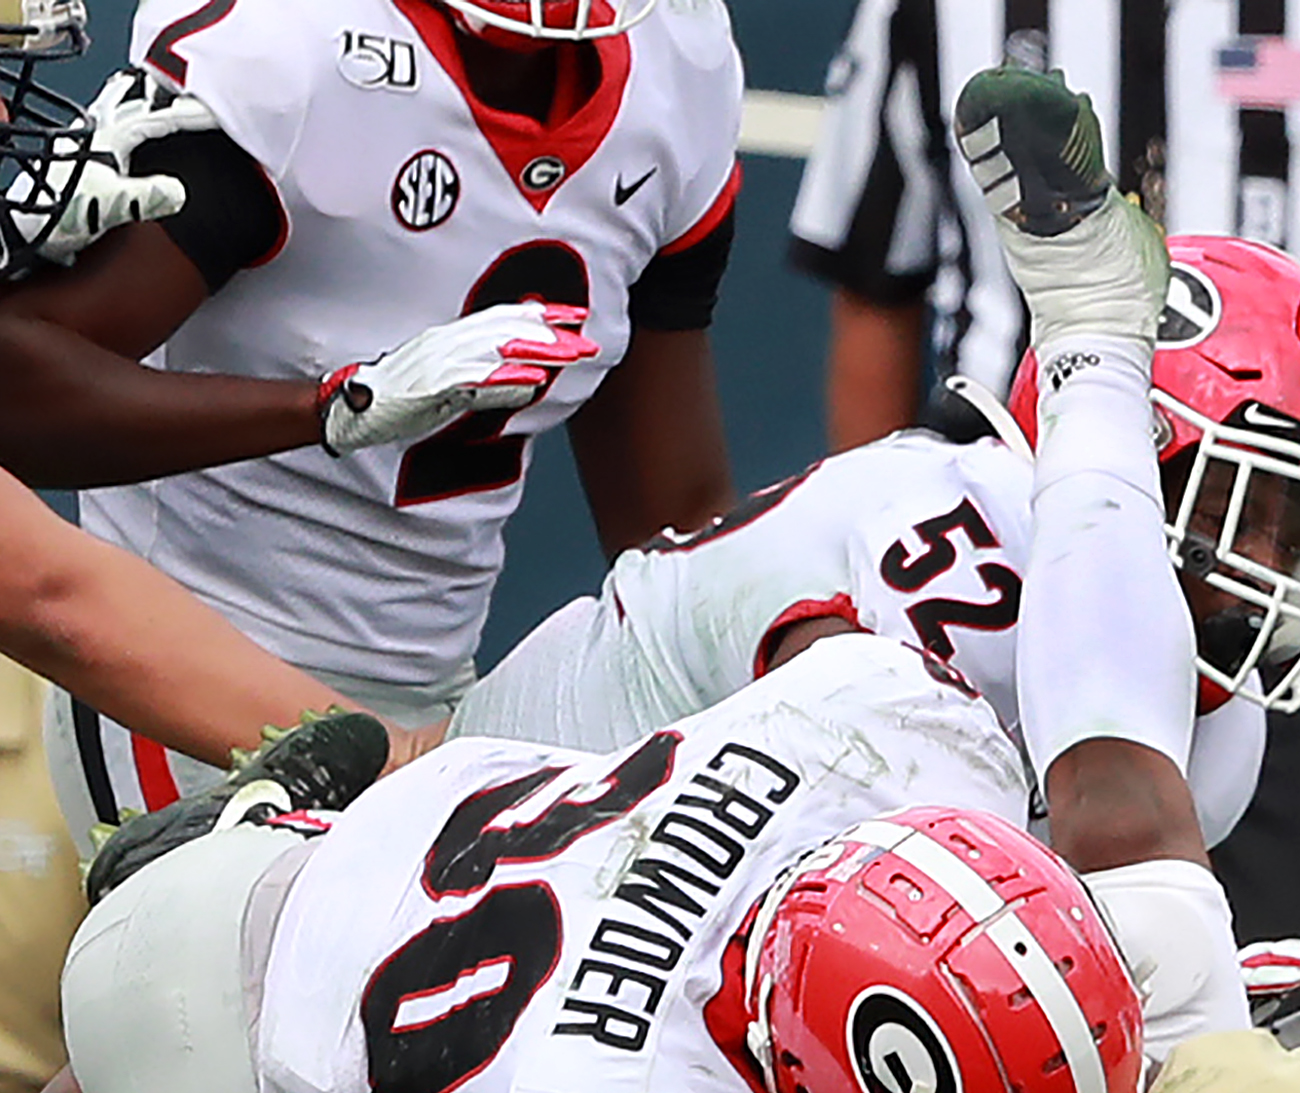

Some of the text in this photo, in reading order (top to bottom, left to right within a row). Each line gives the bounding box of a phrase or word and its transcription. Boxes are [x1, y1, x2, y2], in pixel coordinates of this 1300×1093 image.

[340, 30, 418, 90] 150
[395, 151, 459, 220] SEC
[521, 157, 566, 190] G
[879, 494, 1022, 664] 52
[551, 742, 801, 1052] CROWDER
